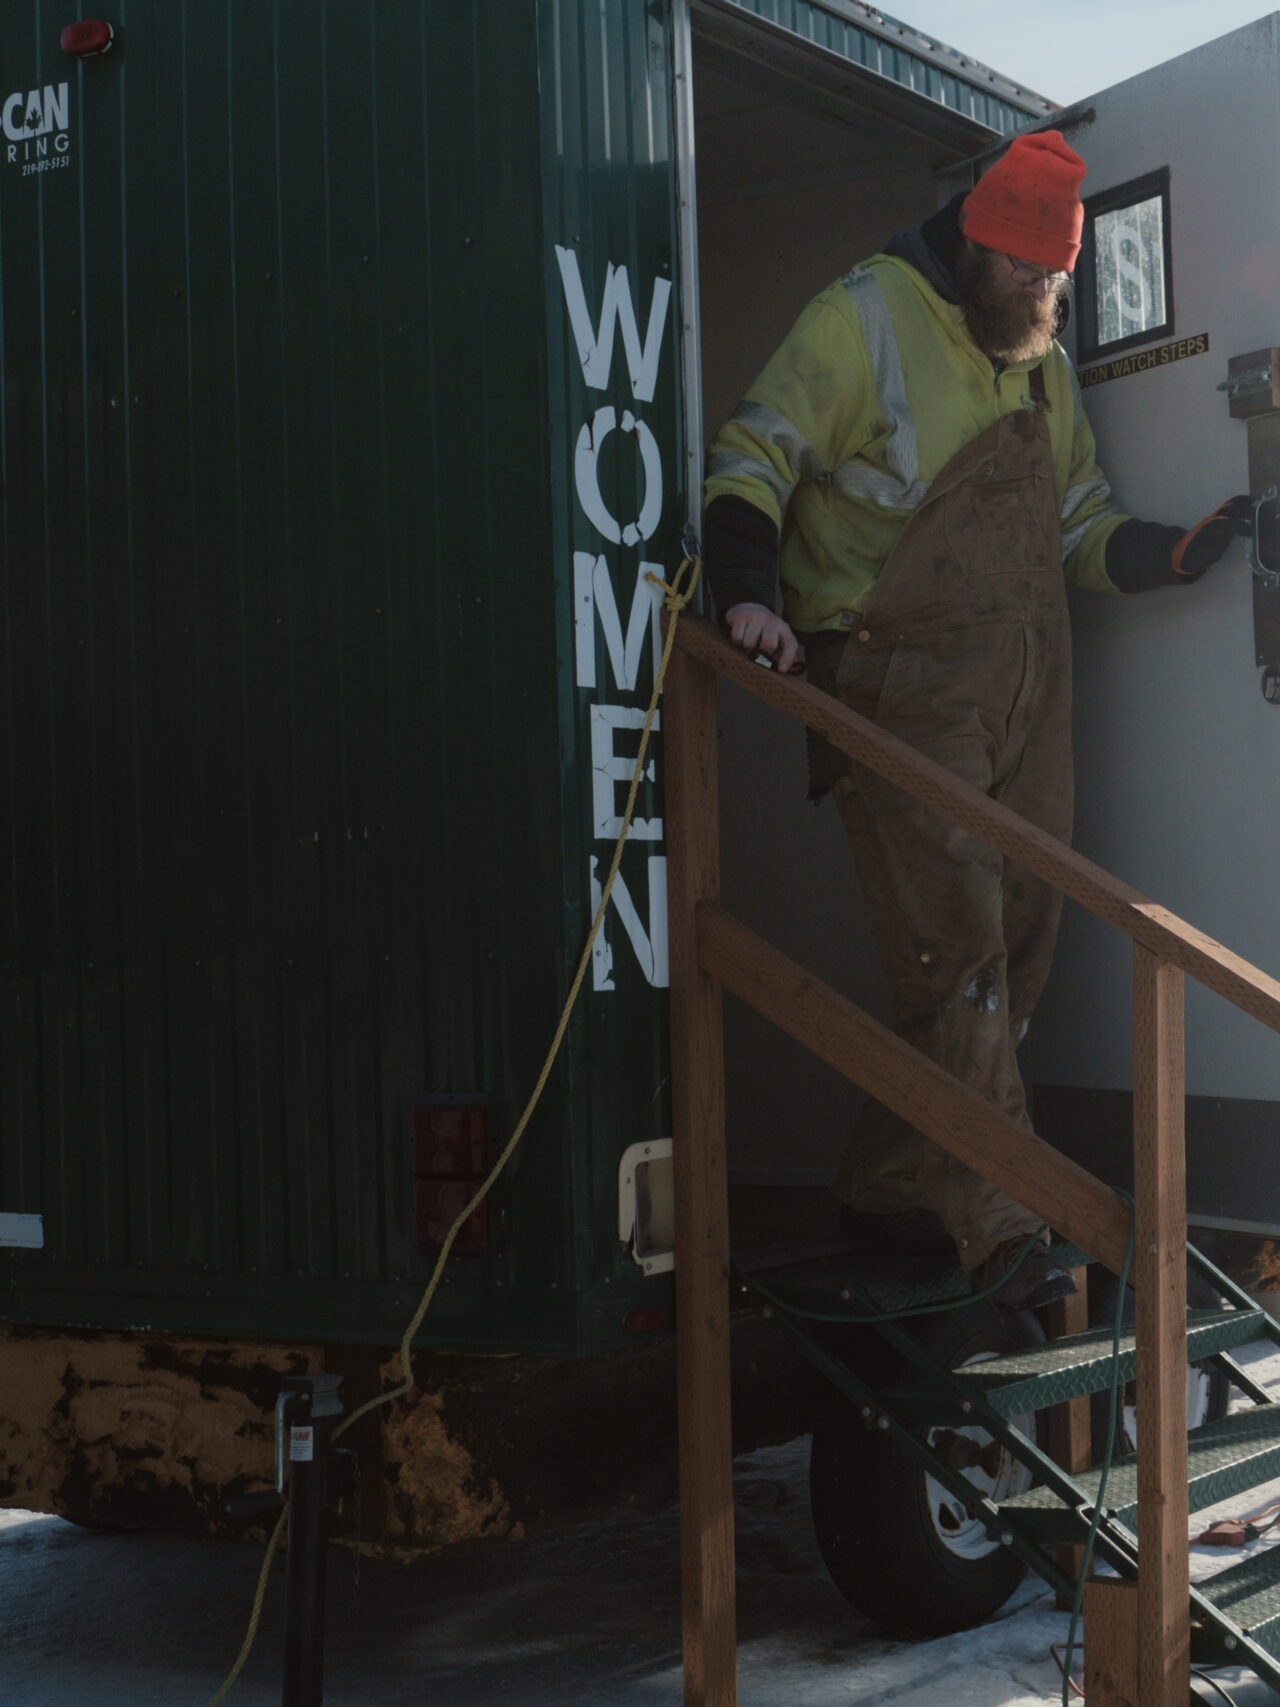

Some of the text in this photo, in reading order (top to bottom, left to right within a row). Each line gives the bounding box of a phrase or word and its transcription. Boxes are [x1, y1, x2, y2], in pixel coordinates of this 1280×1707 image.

[1111, 350, 1157, 378] WATCH
[1160, 336, 1206, 363] STEPS
[554, 244, 672, 992] WOMEN
